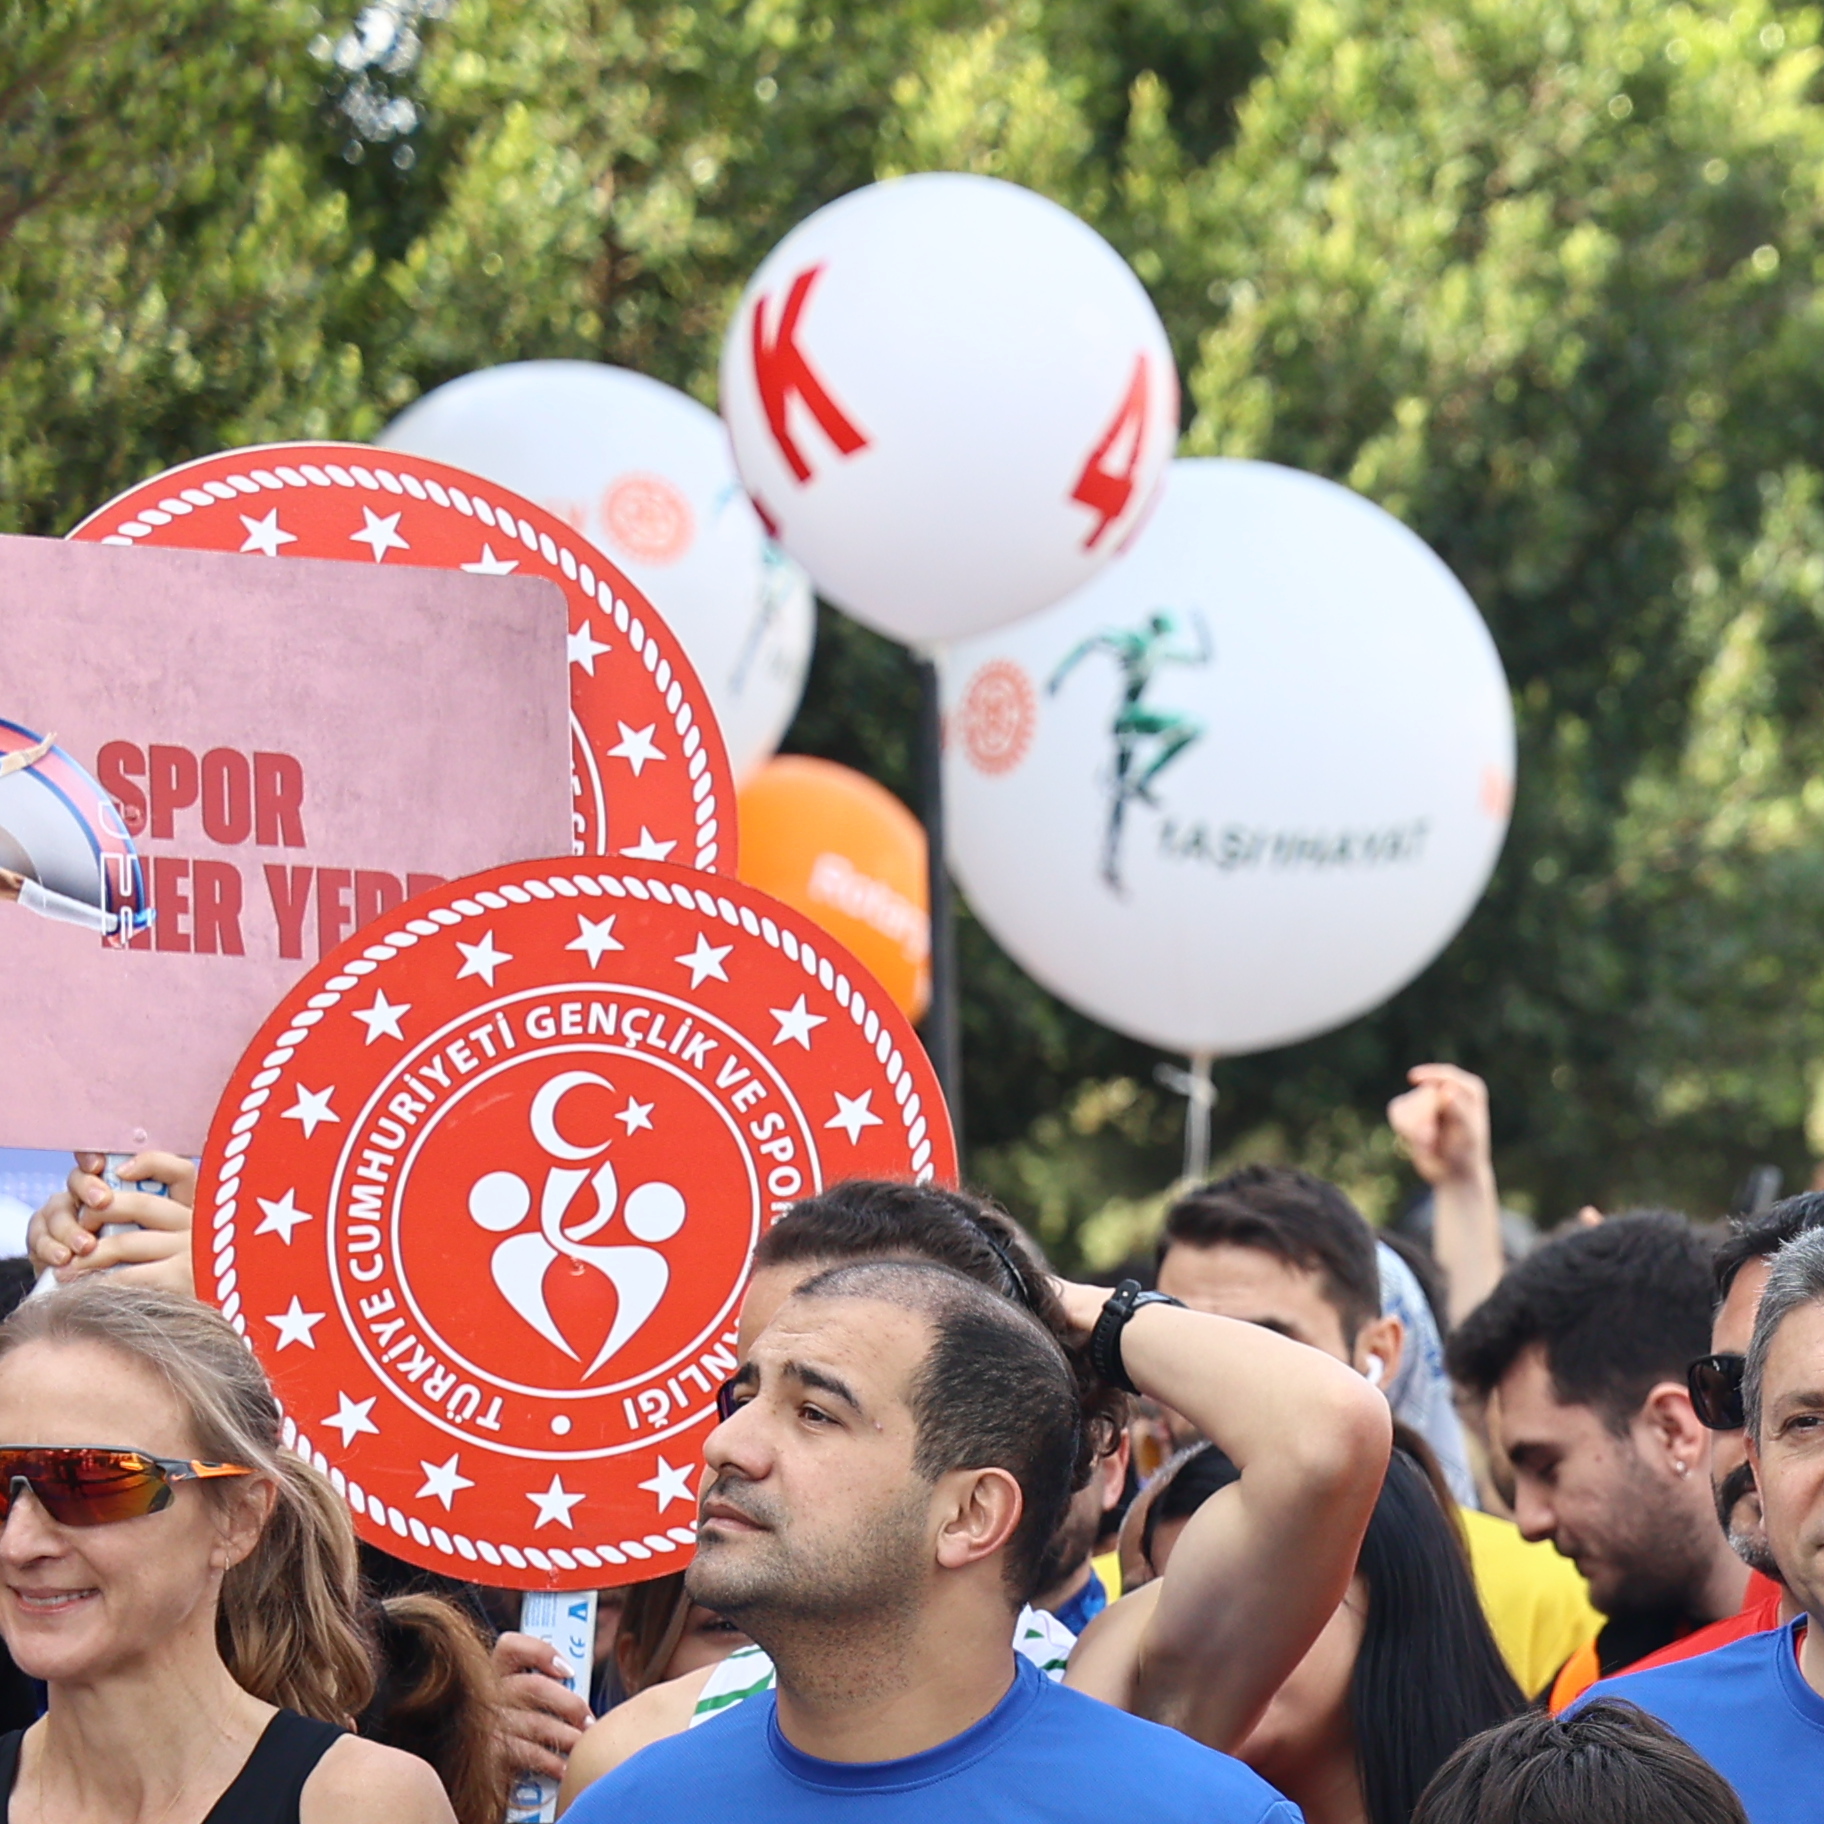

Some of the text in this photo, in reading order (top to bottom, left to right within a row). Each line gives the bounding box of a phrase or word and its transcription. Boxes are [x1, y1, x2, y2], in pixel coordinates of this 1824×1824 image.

[97, 741, 306, 848] SPOR
[101, 852, 452, 959] HER YER
[525, 1001, 718, 1069] GENÇLİK
[715, 1055, 767, 1113] VE
[346, 1012, 517, 1283] CUMHURİYETİ
[366, 1312, 504, 1431] TÜRKİYE
